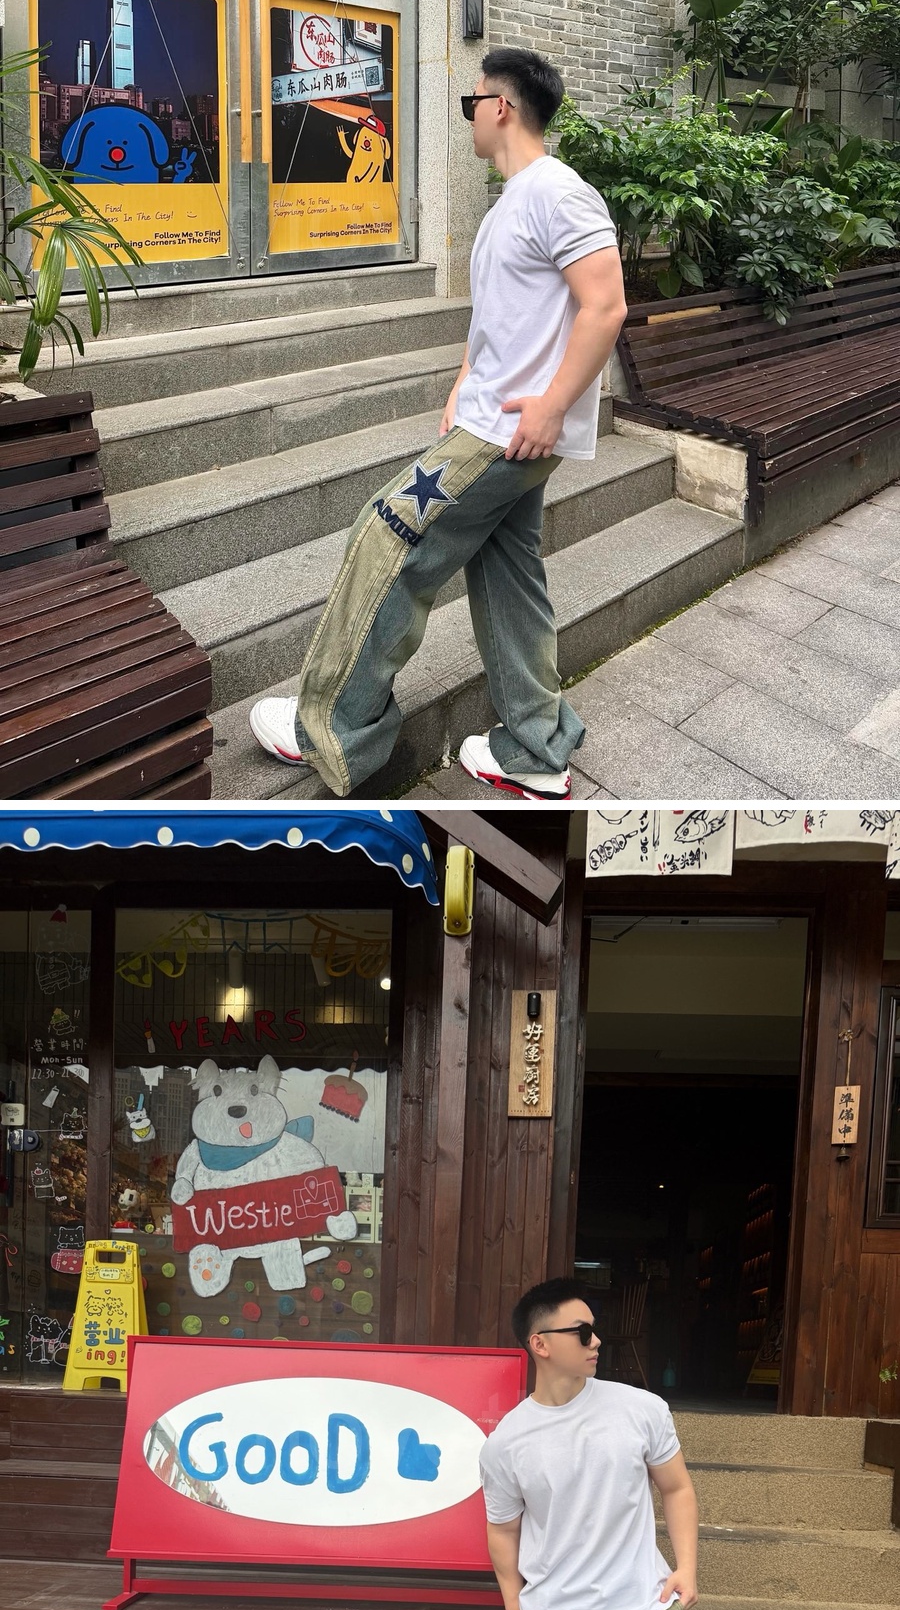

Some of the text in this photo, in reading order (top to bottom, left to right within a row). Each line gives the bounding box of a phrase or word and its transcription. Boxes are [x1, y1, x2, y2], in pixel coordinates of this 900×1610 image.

[287, 71, 348, 97] 东瓜山肉肠
[105, 204, 122, 213] Find
[273, 200, 294, 208] Follow
[308, 198, 315, 206] To
[318, 197, 331, 205] Find
[123, 214, 133, 222] In
[137, 212, 151, 221] The
[155, 211, 174, 222] City!
[144, 239, 176, 247] Corners
[202, 237, 221, 245] City!
[154, 232, 181, 240] Follow
[169, 1009, 307, 1051] YEARS
[185, 1200, 295, 1236] Westie
[84, 1321, 126, 1347] 营业
[86, 1348, 126, 1365] ing!
